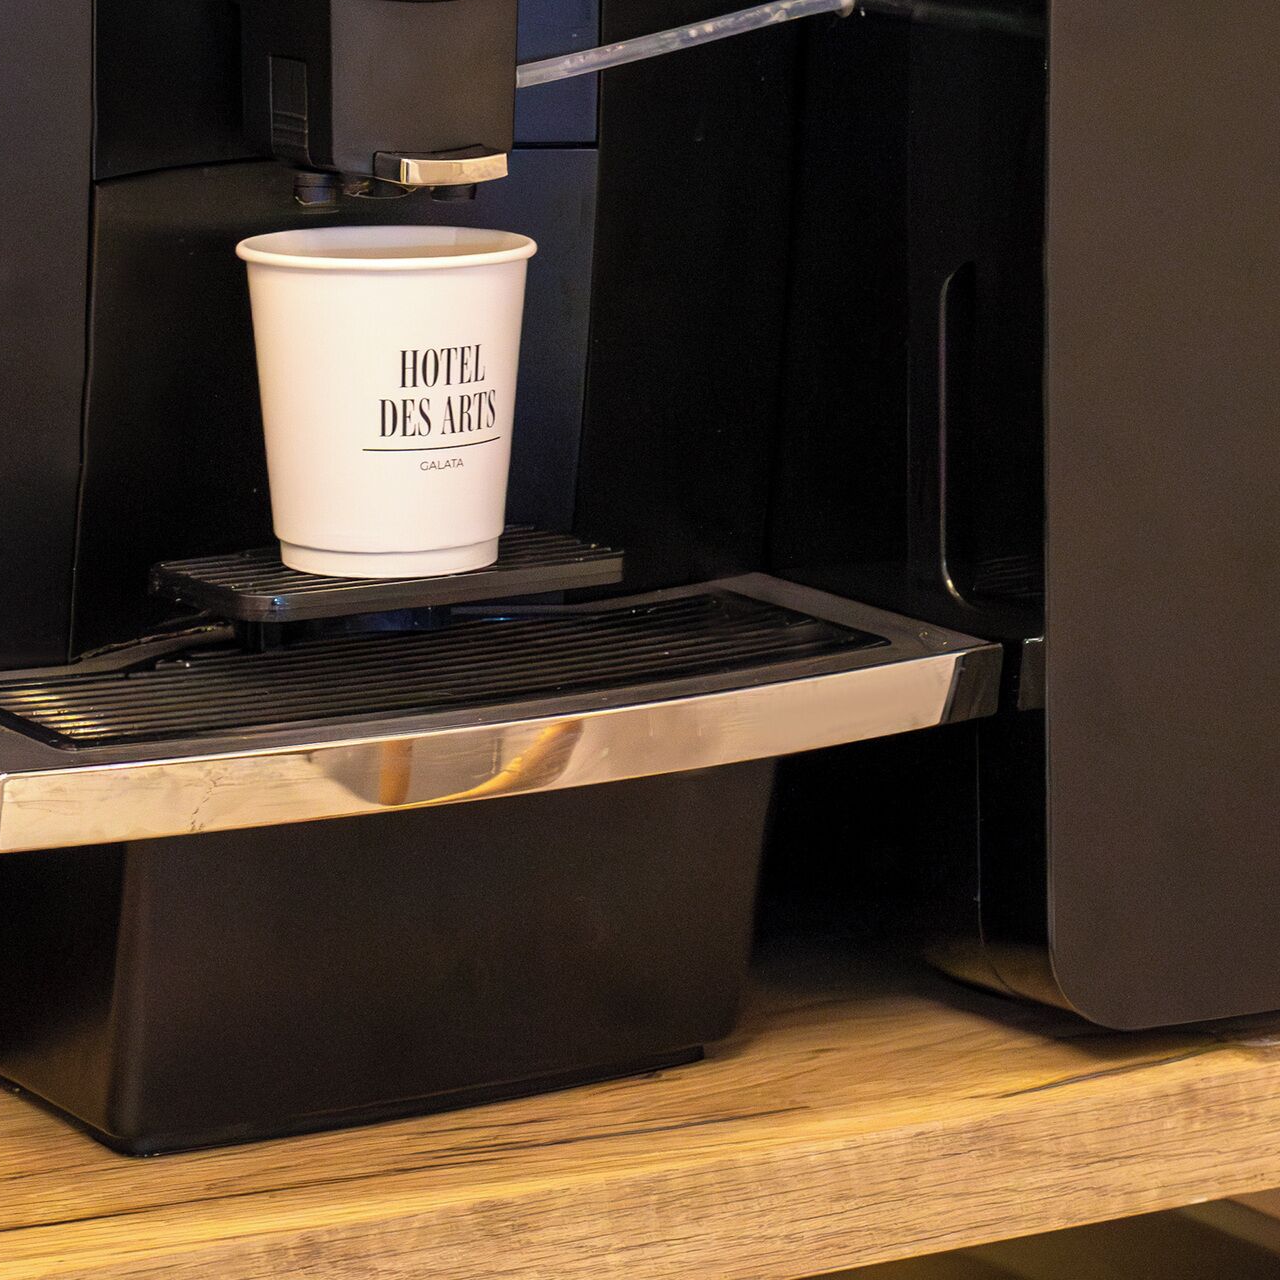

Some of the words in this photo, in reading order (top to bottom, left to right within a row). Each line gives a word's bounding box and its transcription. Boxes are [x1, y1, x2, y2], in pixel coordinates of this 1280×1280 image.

[399, 343, 486, 389] HOTEL
[379, 397, 432, 438] DES
[440, 389, 496, 435] ARTS
[419, 458, 465, 471] GALATA
